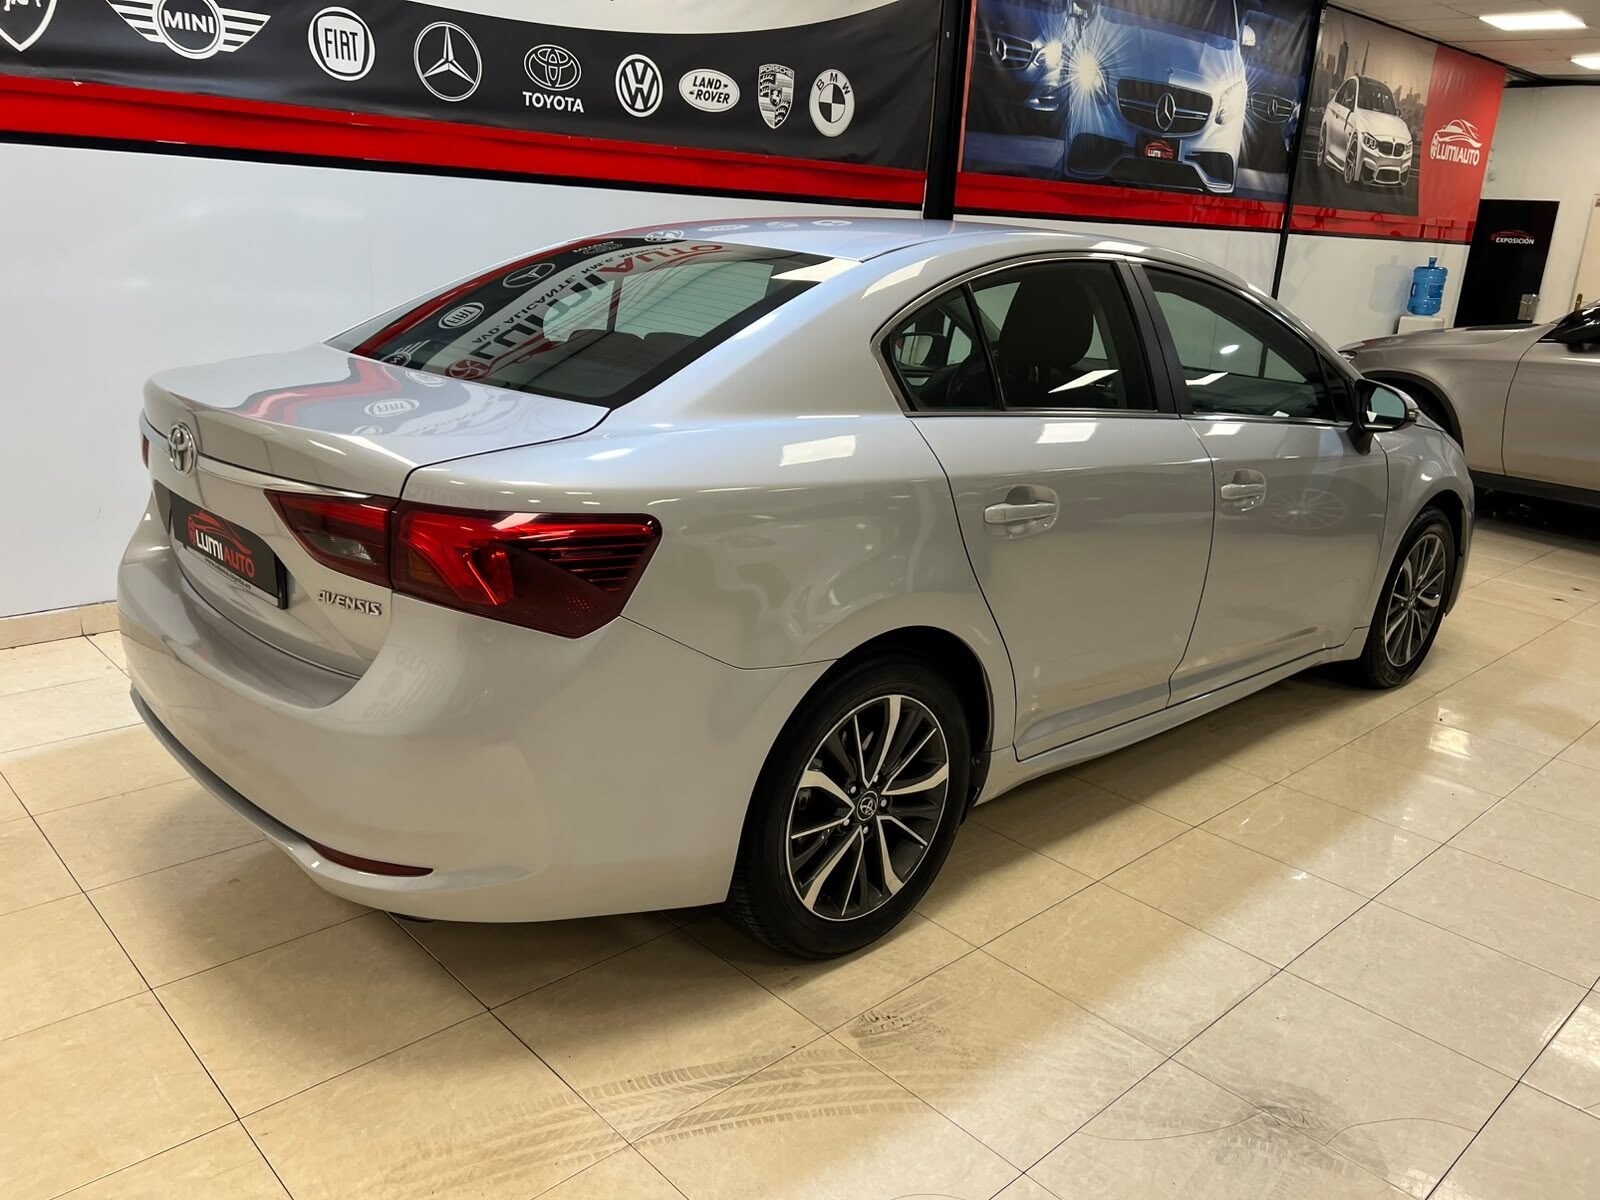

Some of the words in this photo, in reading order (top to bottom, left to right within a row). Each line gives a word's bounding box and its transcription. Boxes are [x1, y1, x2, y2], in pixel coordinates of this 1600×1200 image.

[163, 9, 215, 34] MINI
[324, 28, 358, 62] FIAT
[816, 72, 851, 95] BMW
[522, 91, 584, 113] TOYOTA
[319, 589, 382, 616] AVENSIS
